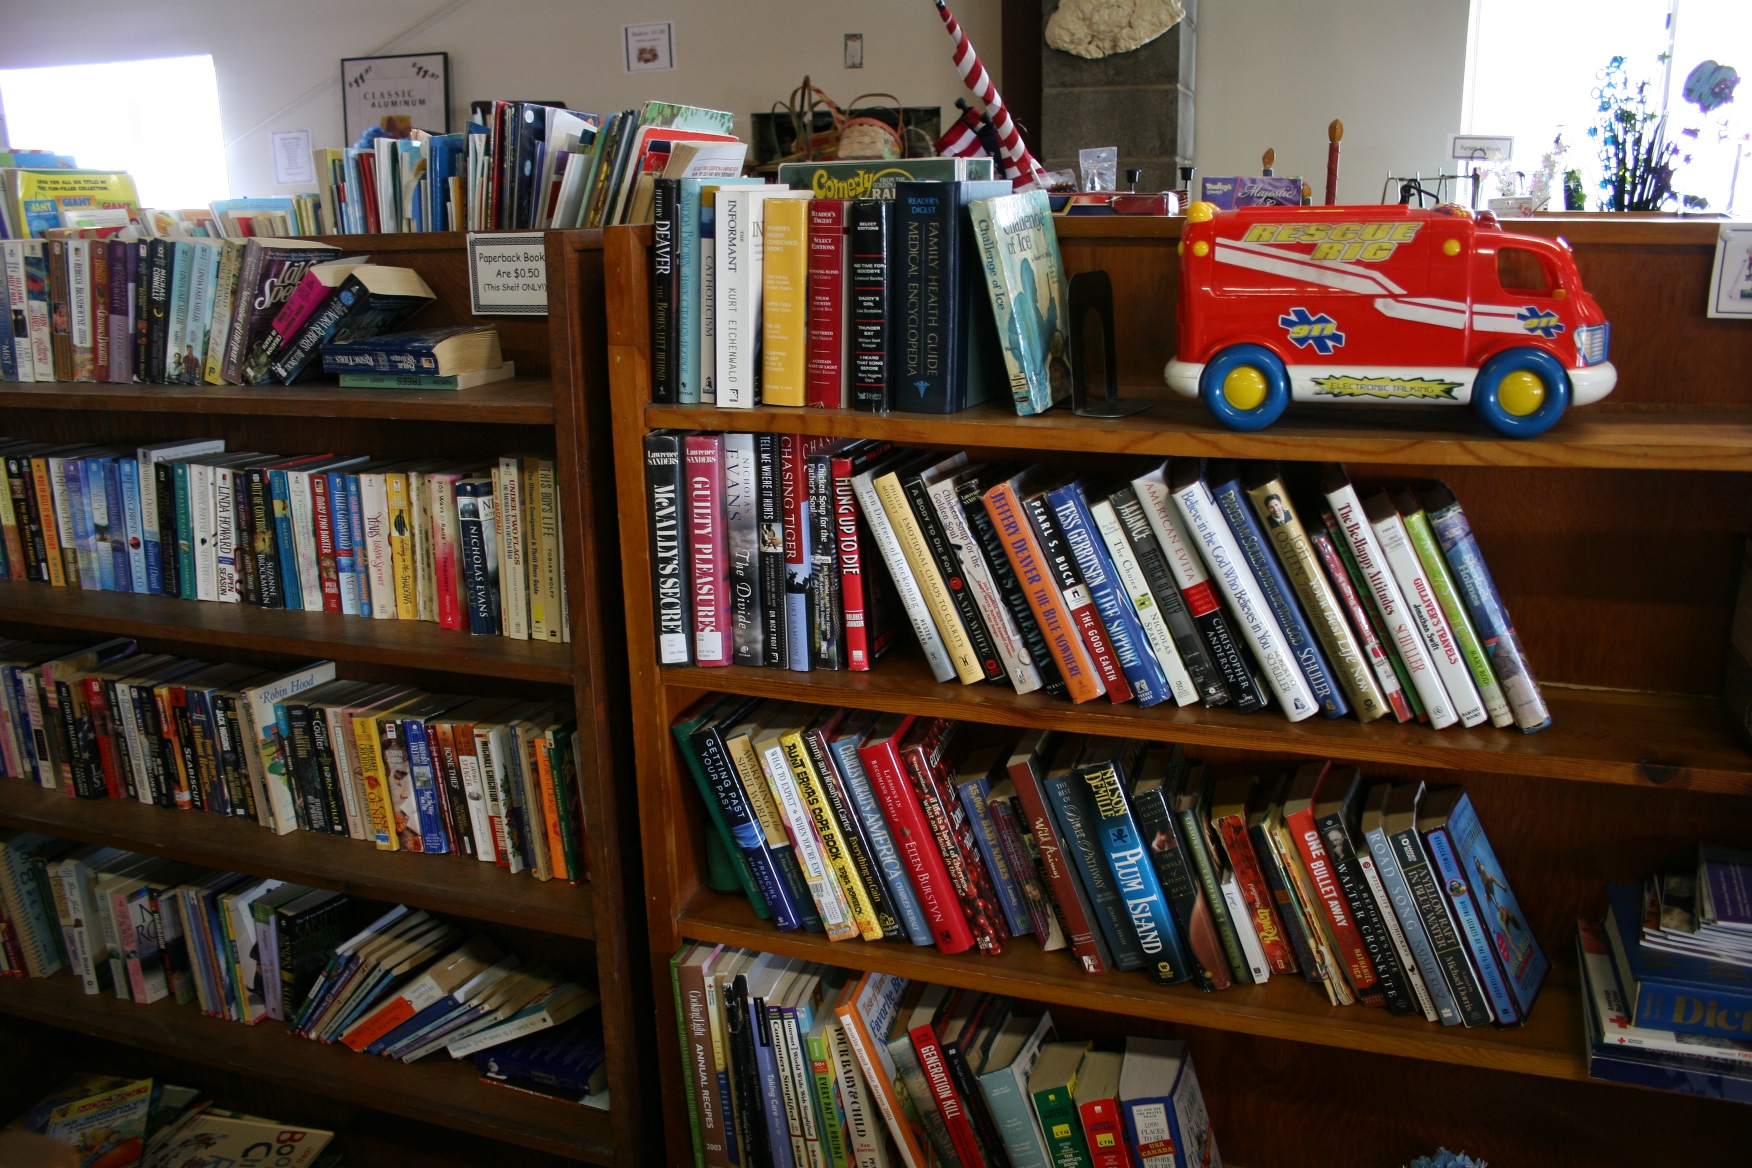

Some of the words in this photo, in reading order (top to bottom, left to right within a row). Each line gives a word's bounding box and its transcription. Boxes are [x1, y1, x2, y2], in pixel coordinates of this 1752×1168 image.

[364, 89, 415, 100] CLASSIC
[371, 99, 426, 108] ALUMINUM
[812, 169, 875, 198] Comedy
[1238, 186, 1295, 200] Majestic
[655, 220, 671, 275] DEAVER
[728, 200, 737, 273] INFORMANT
[908, 222, 919, 277] MEDICAL
[929, 223, 938, 269] FAMILY
[1244, 224, 1423, 243] RESCUE
[1311, 242, 1398, 261] RIG
[479, 253, 521, 265] Paperback
[524, 252, 545, 262] Book
[496, 269, 511, 278] Are
[514, 268, 539, 279] $0.50
[978, 219, 997, 276] Challenge
[995, 290, 1005, 311] Ice
[152, 268, 160, 300] CONNELLY
[484, 284, 500, 292] (This
[502, 283, 520, 291] Shelf
[522, 284, 547, 292] ONLY!)
[705, 255, 714, 337] CATHOLICISM
[728, 287, 737, 313] KURT
[928, 273, 938, 327] HEALTH
[907, 283, 918, 376] ENCYCLOPEDIA
[1290, 323, 1336, 338] 911
[1524, 317, 1558, 329] 911
[728, 320, 738, 383] EICHENWALD
[927, 334, 938, 376] GUIDE
[1329, 383, 1387, 394] ELECTRONIC
[1390, 385, 1435, 395] TALKING
[648, 457, 678, 465] SANDERS
[687, 449, 715, 457] Lawrence
[759, 436, 770, 452] TELL
[761, 454, 771, 465] ME
[540, 468, 551, 489] THIS
[725, 448, 741, 522] EVANS
[743, 457, 751, 515] NICHOLAS
[761, 465, 772, 487] WHERE
[761, 488, 773, 496] IT
[781, 436, 794, 509] CHASING
[835, 477, 854, 513] HUNG
[218, 486, 230, 514] LINDA
[692, 476, 713, 542] GUILTY
[762, 497, 773, 520] HURTS
[219, 515, 231, 554] HOWARD
[543, 516, 554, 538] LIFE
[785, 514, 796, 558] TIGER
[839, 516, 856, 535] UP
[841, 536, 857, 552] TO
[1032, 500, 1053, 536] PEARL
[1048, 540, 1059, 552] S.
[1055, 555, 1076, 586] BUCK
[1056, 500, 1080, 531] TESS
[1068, 528, 1106, 588] GERRITSEN
[1145, 483, 1180, 544] AMERICAN
[1175, 547, 1194, 582] EVITA
[470, 525, 483, 586] NICHOLAS
[477, 586, 488, 618] EVANS
[735, 549, 749, 576] The
[842, 555, 860, 576] DIE
[1113, 539, 1124, 561] The
[1122, 560, 1137, 590] Choice
[1181, 490, 1201, 523] Believe
[1197, 520, 1206, 531] in
[1203, 529, 1216, 547] the
[1211, 546, 1229, 569] God
[1224, 568, 1239, 591] Who
[1233, 587, 1256, 626] Believes
[1251, 623, 1261, 633] in
[1257, 631, 1271, 651] You
[1275, 531, 1305, 577] OSTEEN
[1291, 534, 1306, 564] JOEL
[219, 568, 227, 596] SEASON
[258, 554, 270, 604] BROCKMANN
[267, 561, 276, 596] SUZANNE
[695, 543, 716, 633] PLEASURES
[990, 490, 1021, 537] JEFFERY
[1011, 538, 1043, 586] DEAVER
[1034, 588, 1049, 608] THE
[1042, 607, 1062, 635] BLUE
[1053, 632, 1083, 679] NOWHERE
[1337, 503, 1353, 526] The
[1347, 524, 1374, 573] Be-Happy
[1368, 567, 1395, 617] Attitudes
[1393, 624, 1426, 673] SCHULLER
[1458, 563, 1481, 607] Holmes
[659, 577, 682, 634] SECRE
[735, 582, 751, 629] Divide
[1413, 578, 1441, 627] GULLIVER'S
[1438, 627, 1459, 665] TRAVELS
[1413, 604, 1430, 633] Jonathan
[1425, 632, 1439, 651] Swift
[1080, 612, 1094, 629] THE
[1088, 629, 1105, 654] GOOD
[1099, 655, 1118, 682] EARTH
[1206, 631, 1236, 683] ANDERSEN
[1212, 617, 1250, 690] CHRISTOPHER
[260, 686, 288, 703] Robin
[291, 675, 314, 692] Hood
[184, 747, 200, 806] SEABISCUIT
[481, 741, 492, 767] MICHAEL
[488, 770, 498, 802] CRICHTON
[701, 752, 717, 780] YOUR
[715, 785, 731, 811] PAST
[705, 738, 732, 788] GETTING
[729, 792, 745, 817] PAST
[839, 744, 861, 774] CHARLES
[785, 743, 807, 768] AUNT
[797, 768, 819, 805] ERMA'S
[813, 804, 831, 832] COPE
[823, 834, 843, 861] BOOK
[851, 773, 876, 811] KURALT'S
[1084, 774, 1116, 820] DEMILLE
[1101, 768, 1128, 817] NELSON
[863, 811, 902, 881] AMERICA
[1304, 831, 1324, 859] ONE
[905, 841, 923, 872] ELLEN
[917, 872, 944, 922] BURSTYN
[1111, 847, 1144, 893] PLUM
[1128, 894, 1162, 953] ISLAND
[1310, 861, 1335, 899] BULLET
[1369, 833, 1394, 878] ROAD
[1392, 887, 1417, 930] SONG
[154, 913, 165, 949] WAMBAUGH
[1328, 900, 1348, 927] AWAY
[1337, 864, 1365, 919] WALTER
[1362, 925, 1396, 998] CRONKITE
[696, 1044, 707, 1087] ANNUAL
[702, 1089, 714, 1129] RECIPES
[783, 1075, 796, 1121] Simplified
[921, 1045, 953, 1098] GENERATION
[942, 1100, 960, 1120] KILL
[706, 1143, 722, 1151] 2003
[1141, 1147, 1173, 1156] CANADA
